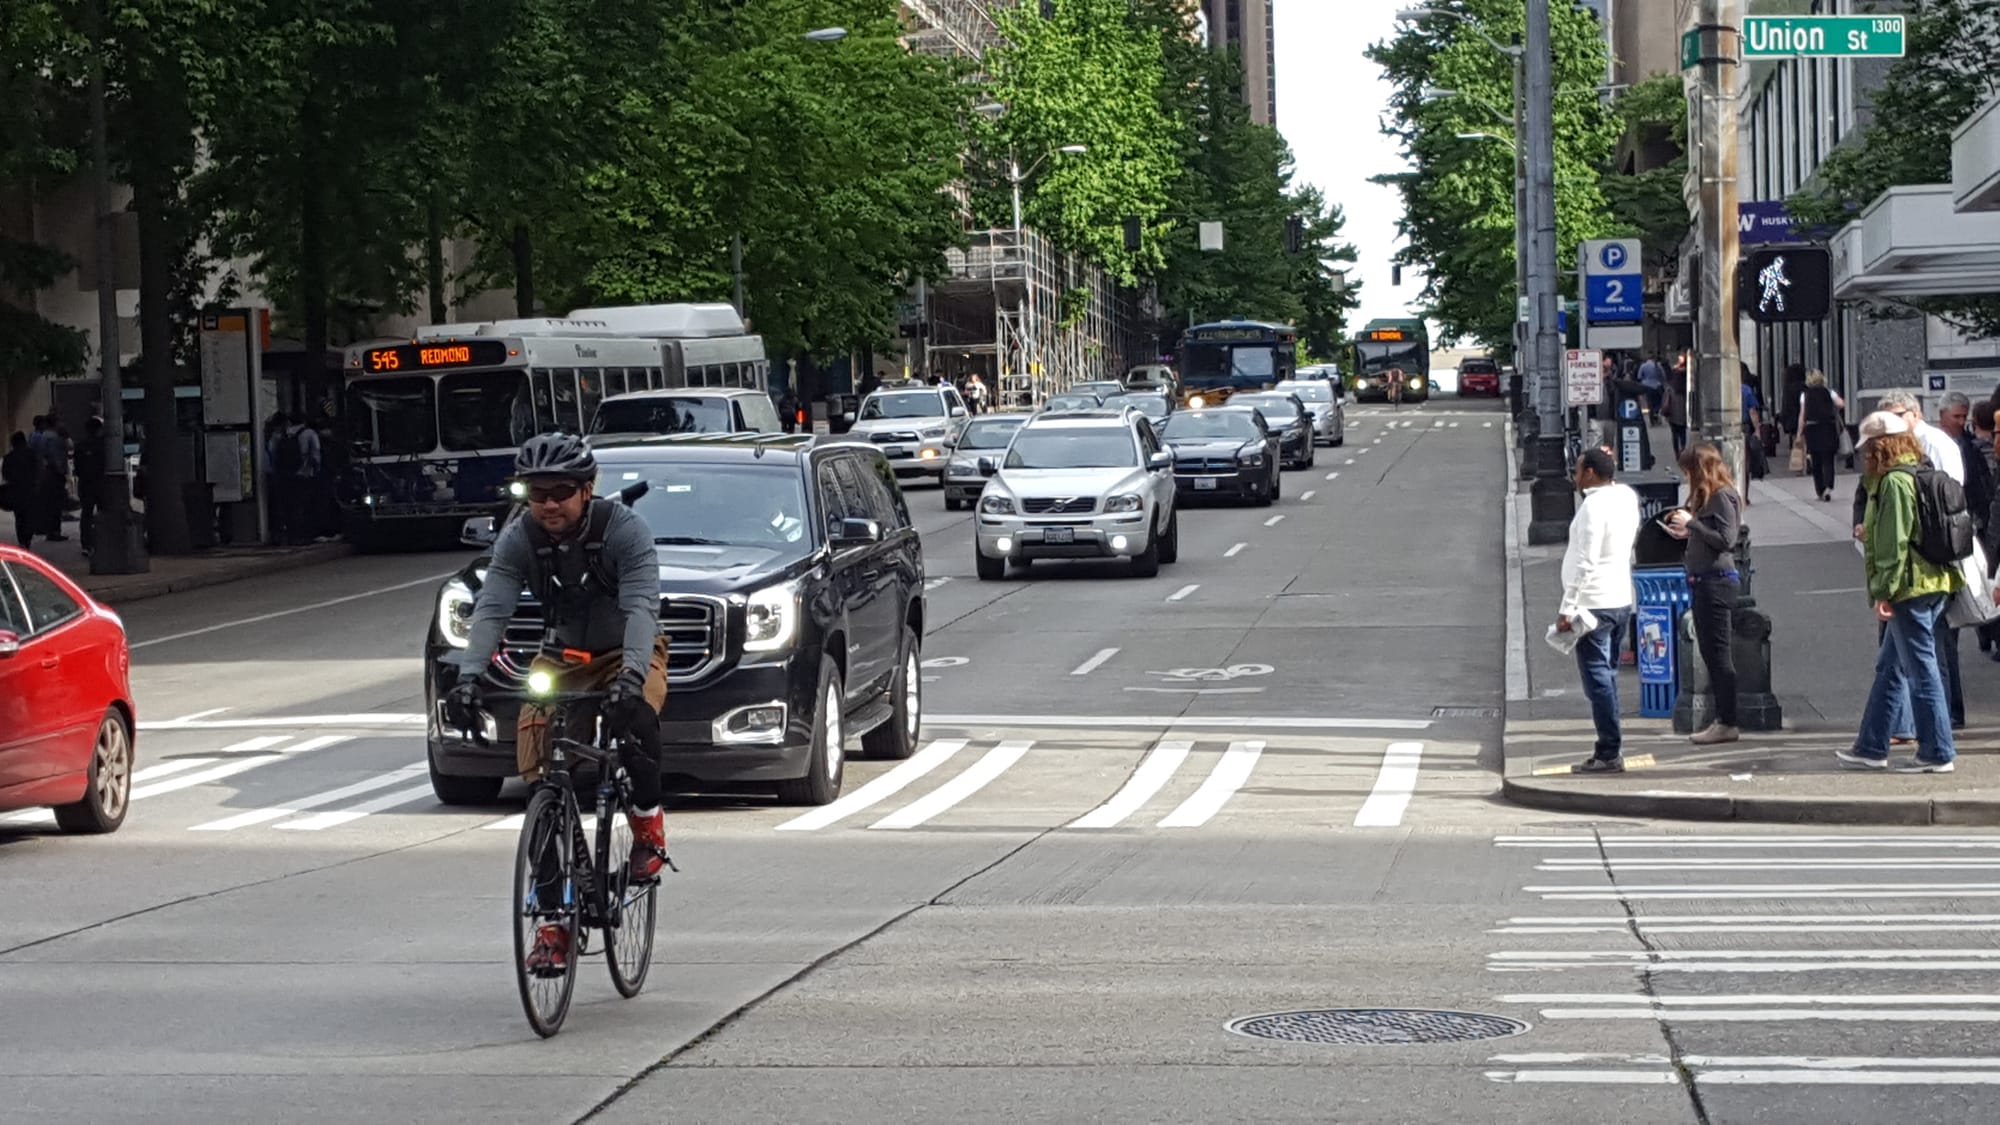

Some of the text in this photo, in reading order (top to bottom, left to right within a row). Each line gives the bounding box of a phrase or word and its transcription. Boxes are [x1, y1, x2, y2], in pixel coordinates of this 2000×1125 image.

[1750, 20, 1900, 50] Union St 1300
[1607, 247, 1622, 266] P
[1605, 279, 1624, 304] 2
[371, 346, 470, 371] 545 REDMOND
[1931, 379, 1944, 388] W
[1624, 399, 1638, 418] P
